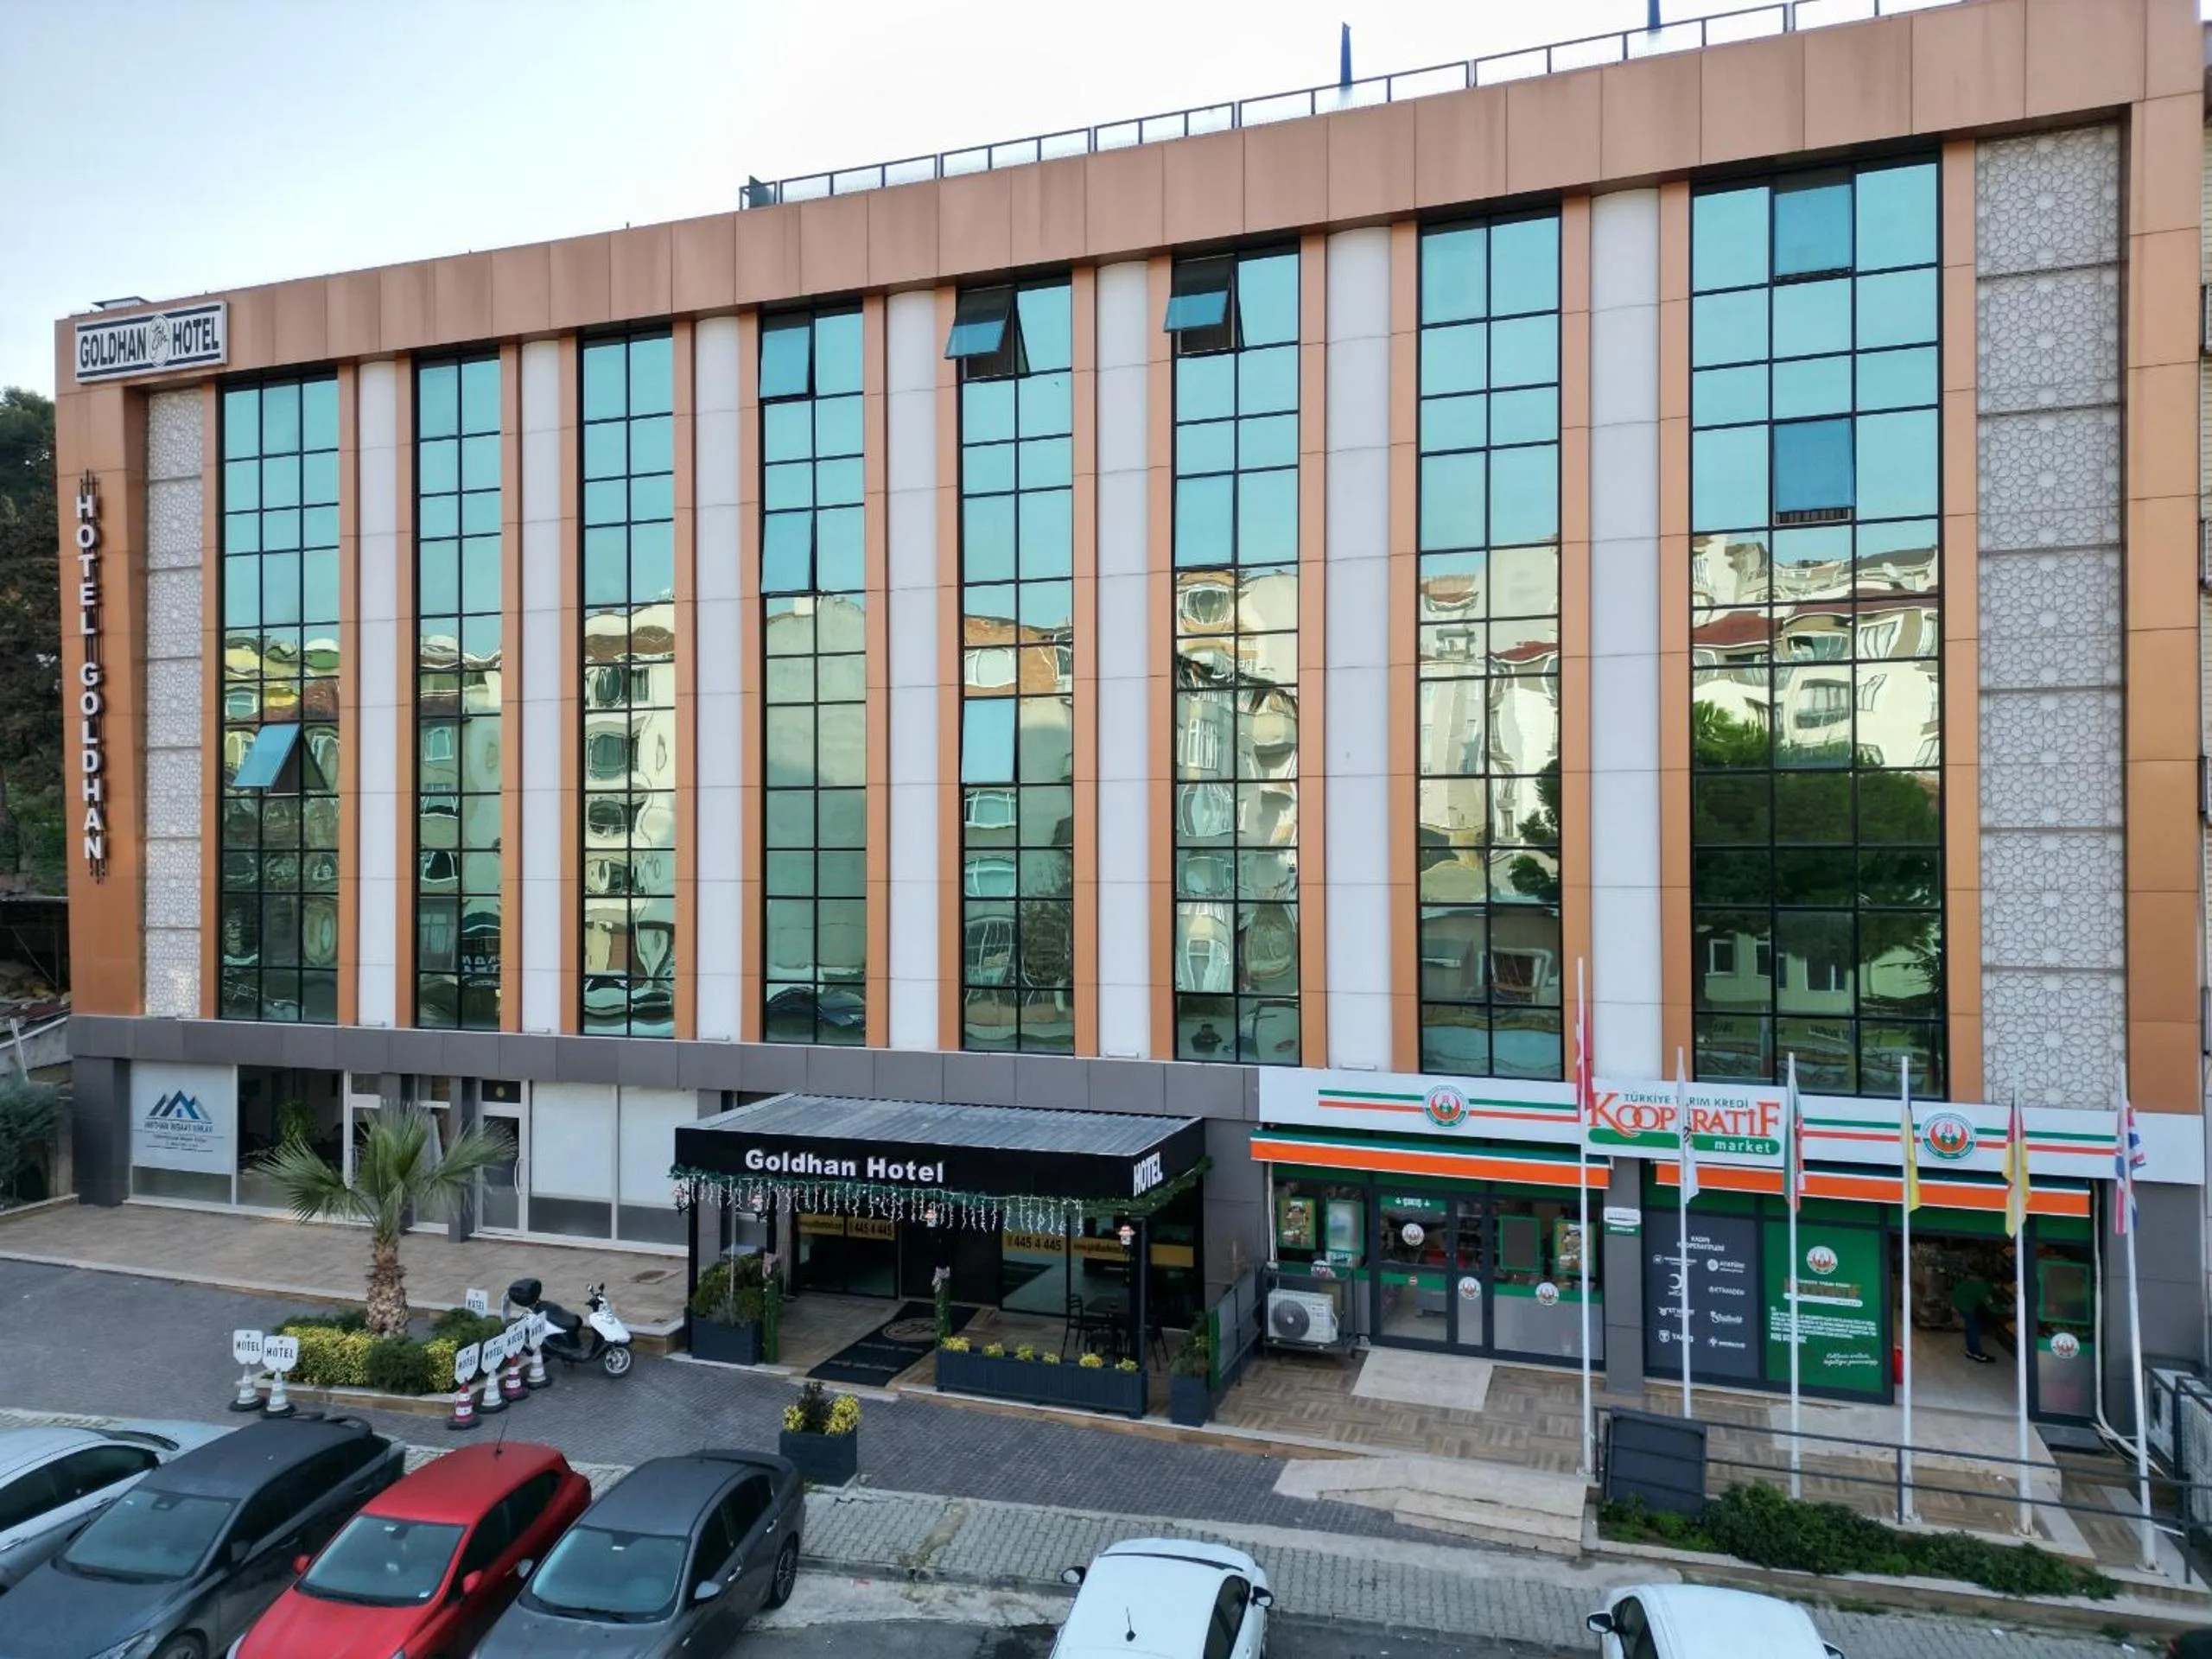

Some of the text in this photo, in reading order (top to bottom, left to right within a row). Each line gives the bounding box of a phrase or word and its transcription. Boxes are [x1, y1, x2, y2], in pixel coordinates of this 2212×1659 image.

[80, 327, 147, 368] GOLDHAN
[173, 316, 219, 356] HOTEL
[76, 494, 103, 859] HOTEL GOLDHAN
[1624, 1090, 1671, 1103] TÜRKİYE
[1714, 1097, 1749, 1108] KREDİ
[1588, 1091, 1782, 1138] KOOPRATİF
[1714, 1140, 1770, 1154] market
[745, 1148, 944, 1183] Goldhan Hotel
[1134, 1152, 1163, 1197] HOTEL
[1014, 1235, 1032, 1249] 445
[1035, 1236, 1040, 1249] 4
[1044, 1237, 1062, 1251] 445
[236, 1340, 261, 1351] HOTEL
[266, 1347, 294, 1359] HOTEL
